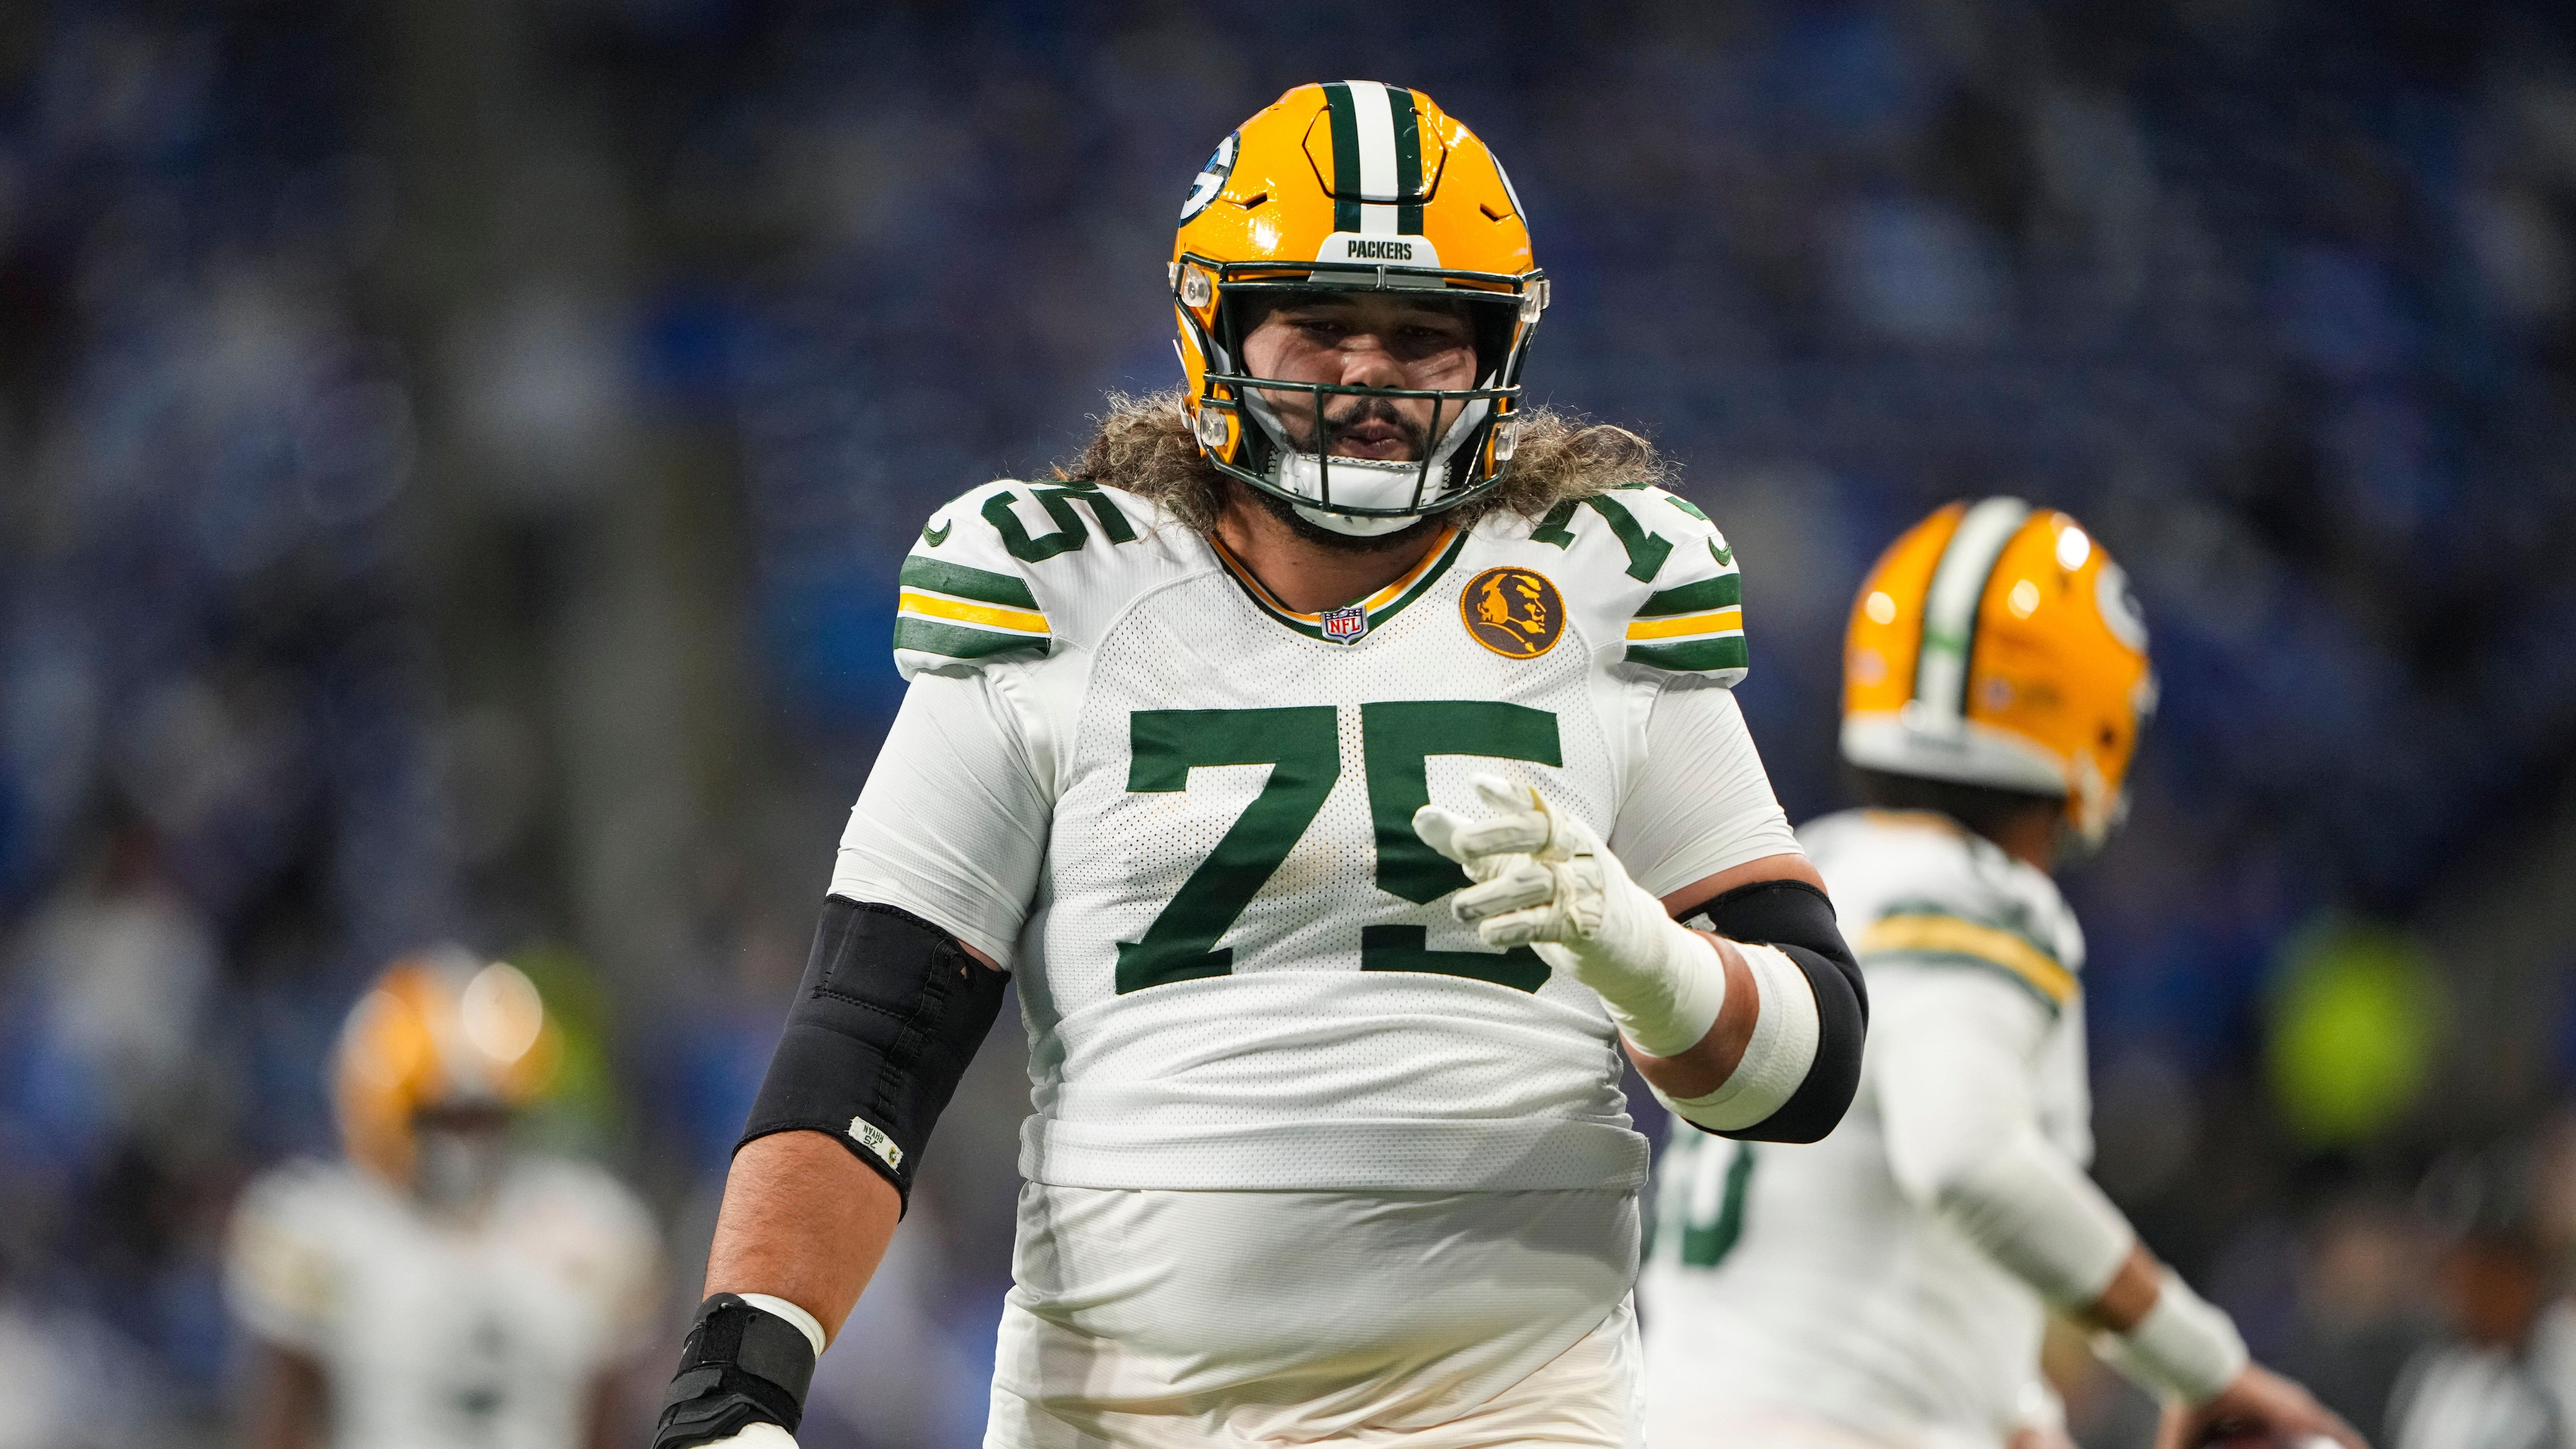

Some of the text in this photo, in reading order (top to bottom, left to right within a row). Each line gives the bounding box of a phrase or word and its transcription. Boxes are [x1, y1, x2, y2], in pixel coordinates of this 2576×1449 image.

[1348, 240, 1412, 260] PACKERS
[981, 481, 1138, 564] 5
[1329, 618, 1360, 634] NFL
[1115, 700, 1563, 995] 75
[863, 1124, 884, 1144] RHYAN
[863, 1135, 878, 1149] 75
